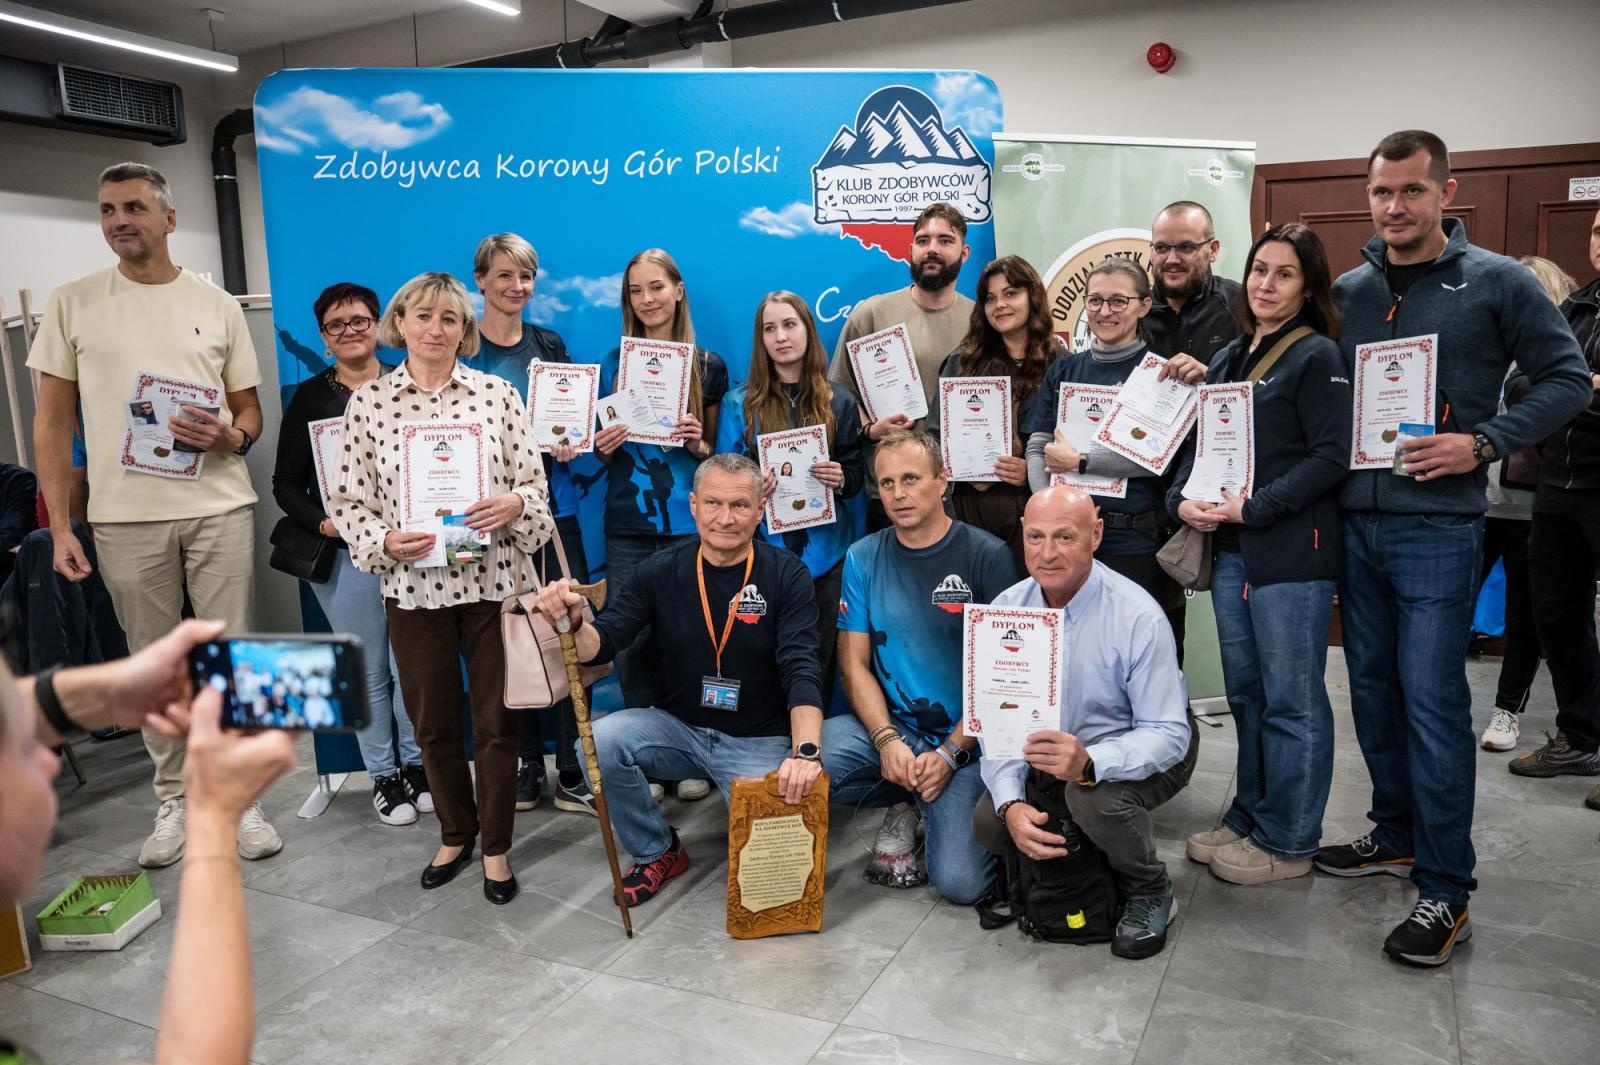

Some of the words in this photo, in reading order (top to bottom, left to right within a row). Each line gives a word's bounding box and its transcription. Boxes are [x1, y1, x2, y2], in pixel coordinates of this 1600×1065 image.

[313, 150, 481, 188] Zdobywca
[496, 153, 609, 185] Korony
[624, 148, 683, 178] Gór
[695, 146, 781, 175] Polski
[837, 178, 873, 191] KLUB
[878, 172, 975, 190] ZDOBYWCÓW
[842, 193, 890, 205] KORONY
[894, 191, 919, 203] GÓR
[923, 190, 960, 202] POLSKI
[865, 339, 892, 352] DYPLOM
[640, 350, 672, 360] DYPLOM
[1377, 352, 1413, 363] DYPLOM
[159, 386, 197, 400] DYPM
[1080, 396, 1113, 404] DYPLOM
[1213, 396, 1237, 405] DYPLOM
[424, 433, 463, 442] DYPLOM
[778, 439, 808, 449] DYPLOM
[992, 620, 1035, 631] DYPLOM
